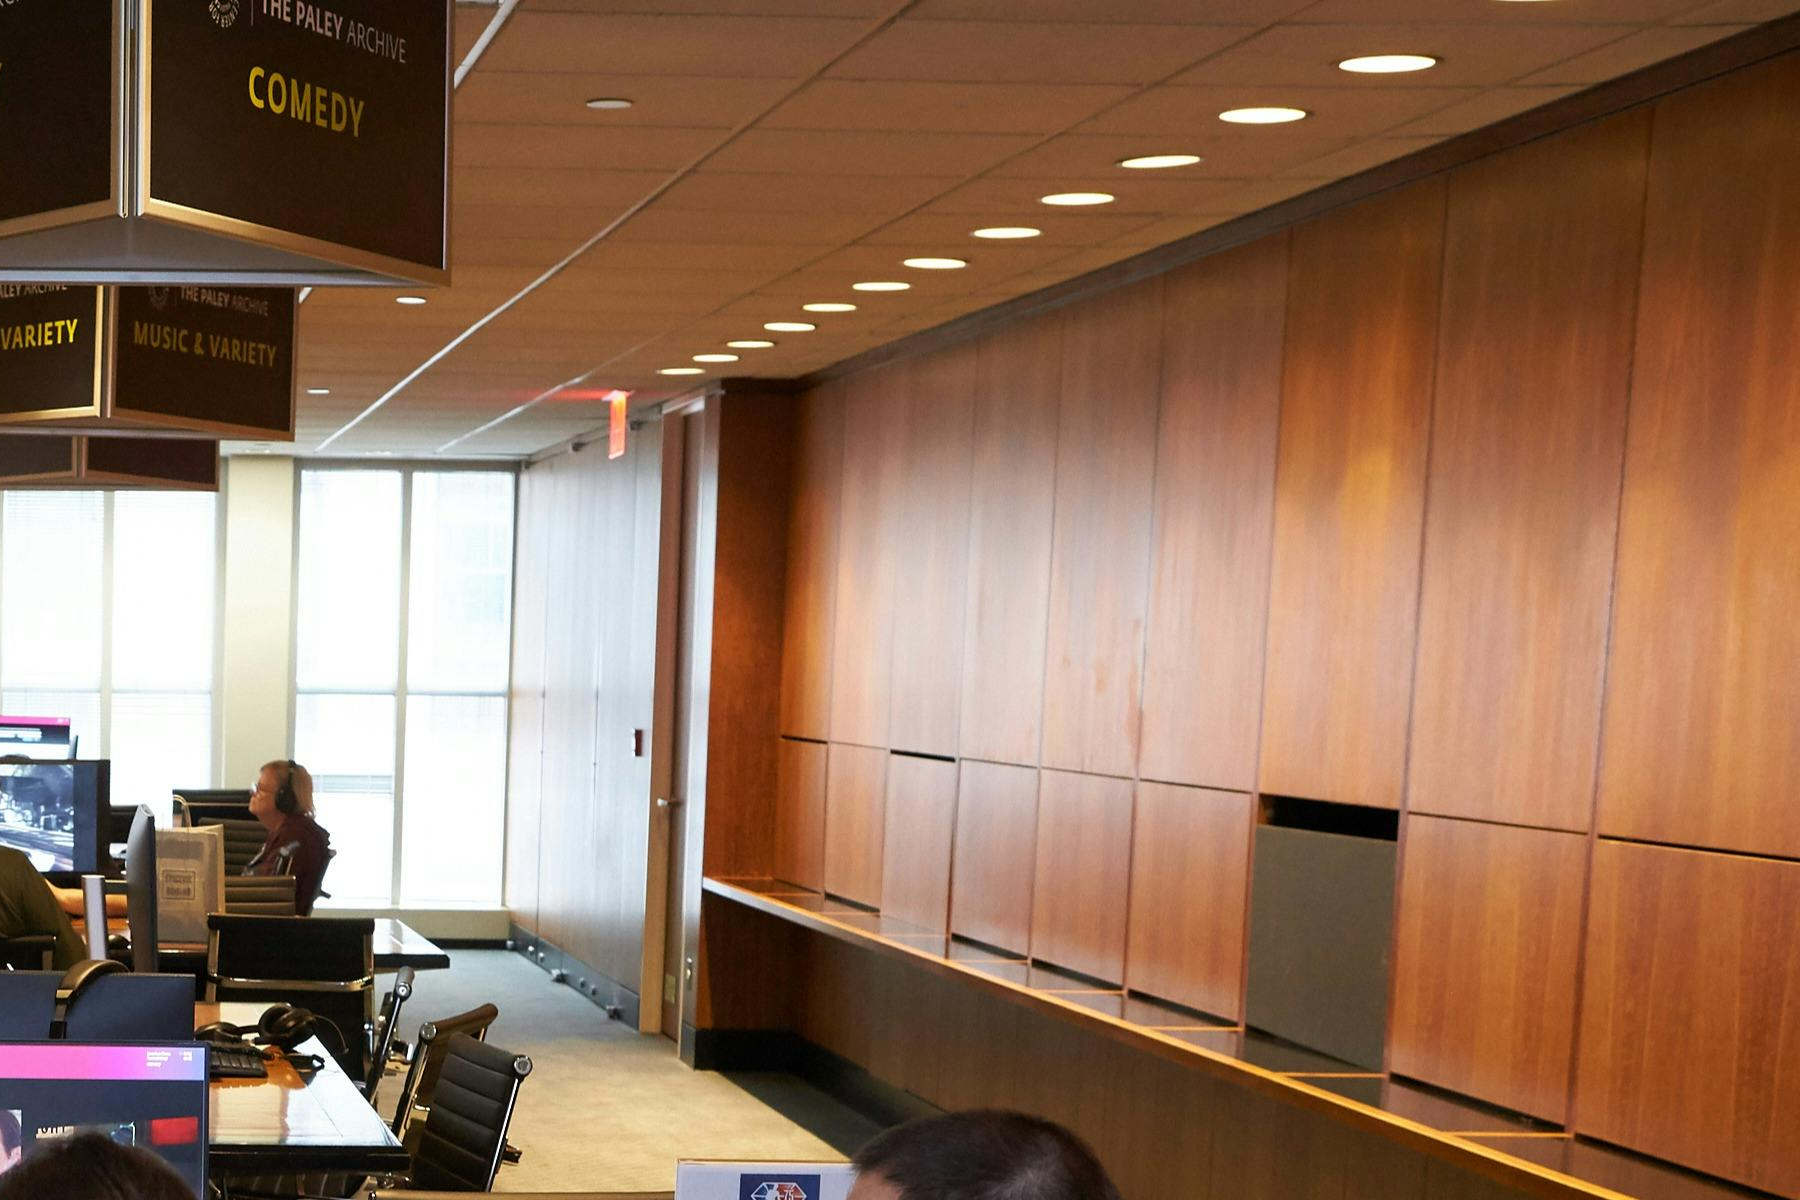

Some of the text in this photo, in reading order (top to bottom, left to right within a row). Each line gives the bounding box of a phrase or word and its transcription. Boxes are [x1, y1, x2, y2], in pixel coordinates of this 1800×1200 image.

[262, 0, 406, 63] THE PALEY ARCHIVE
[249, 66, 364, 137] COMEDY
[181, 286, 199, 302] THE
[201, 288, 230, 308] PALEY
[1, 319, 78, 350] VARIETY
[134, 321, 278, 367] MUSIC & VARIETY
